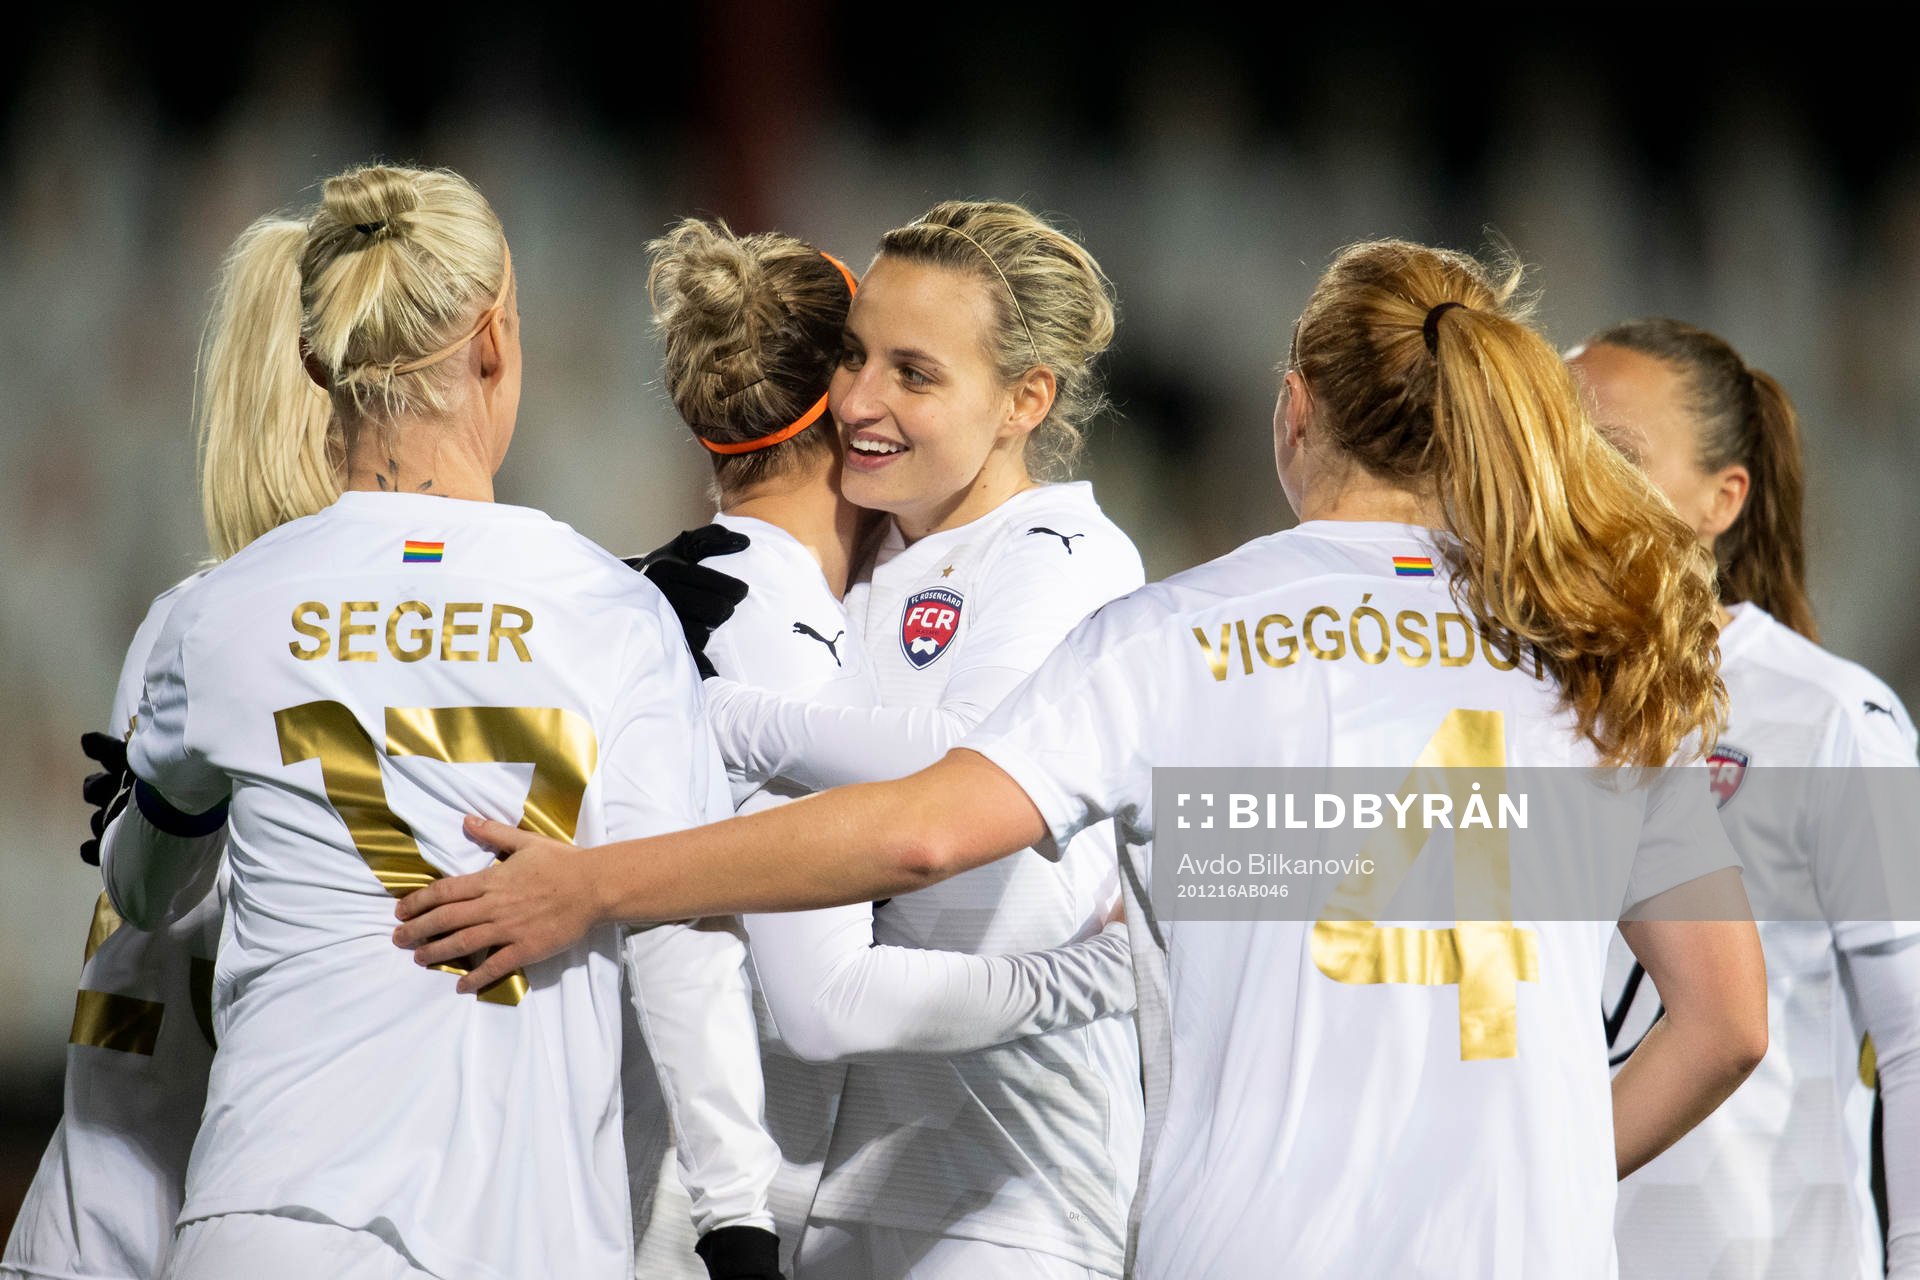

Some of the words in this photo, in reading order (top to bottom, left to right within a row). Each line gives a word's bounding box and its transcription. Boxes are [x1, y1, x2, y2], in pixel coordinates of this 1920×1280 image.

[288, 601, 534, 663] SEGER
[906, 607, 956, 630] FCR
[273, 700, 599, 1006] 17
[1310, 708, 1540, 1061] 4
